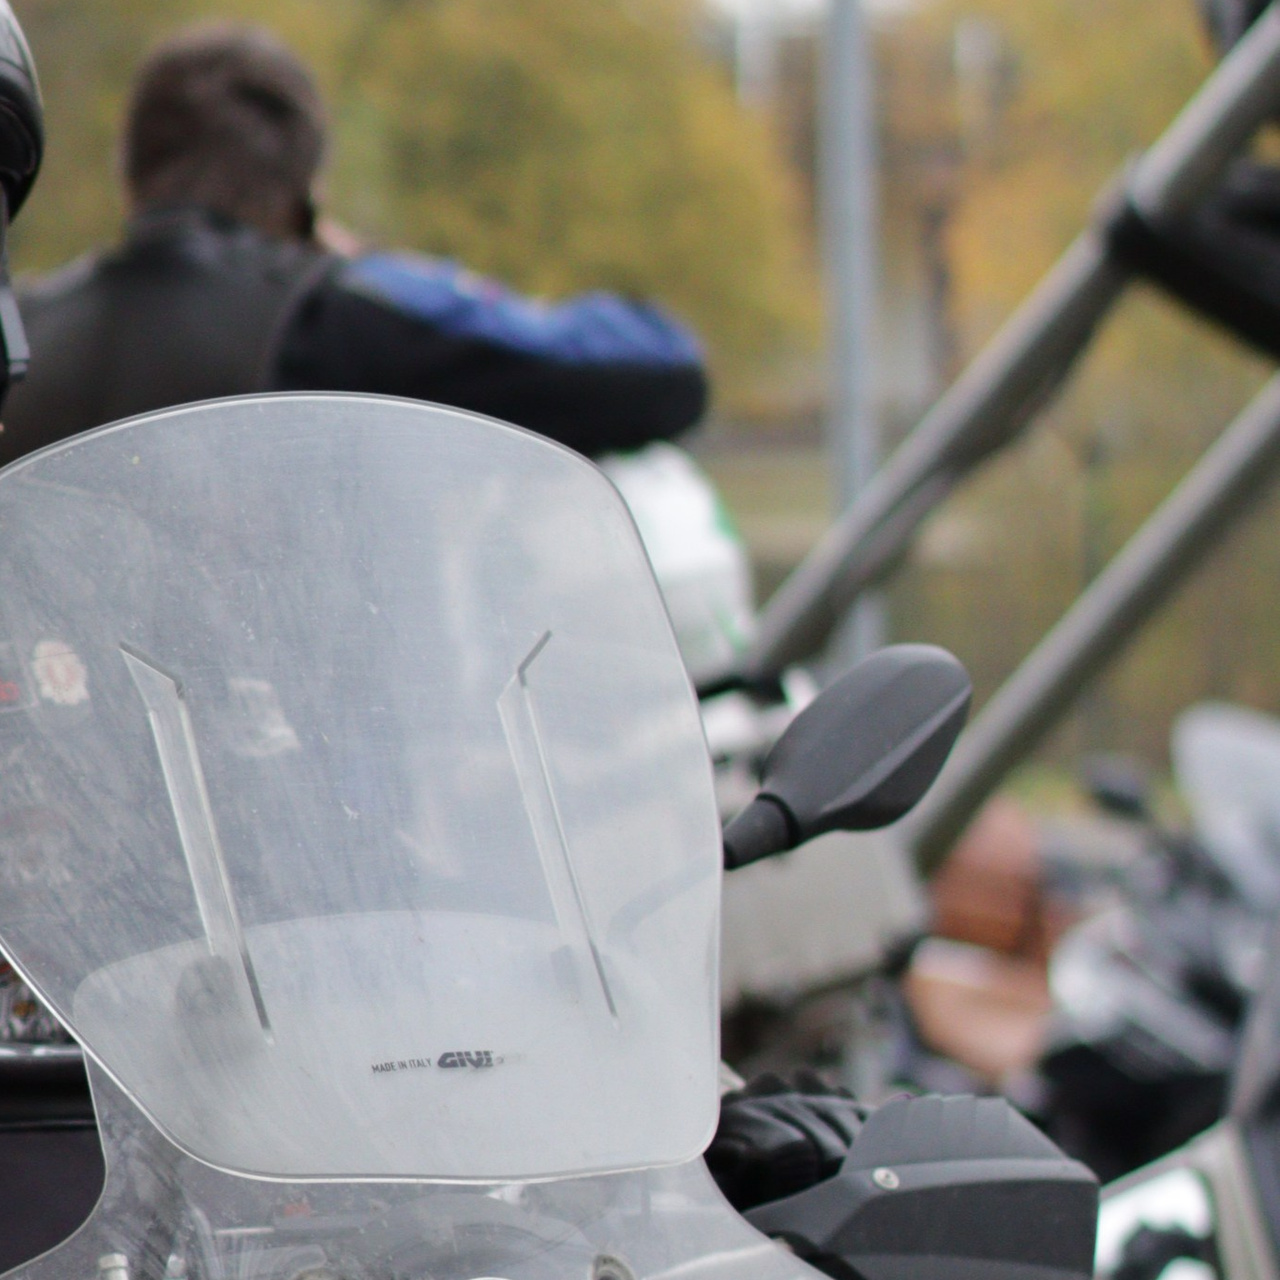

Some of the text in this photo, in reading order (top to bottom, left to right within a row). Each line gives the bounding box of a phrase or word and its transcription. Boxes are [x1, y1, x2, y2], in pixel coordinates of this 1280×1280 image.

[372, 1062, 396, 1074] MADE
[398, 1061, 408, 1071] IN
[410, 1057, 432, 1070] ITALY
